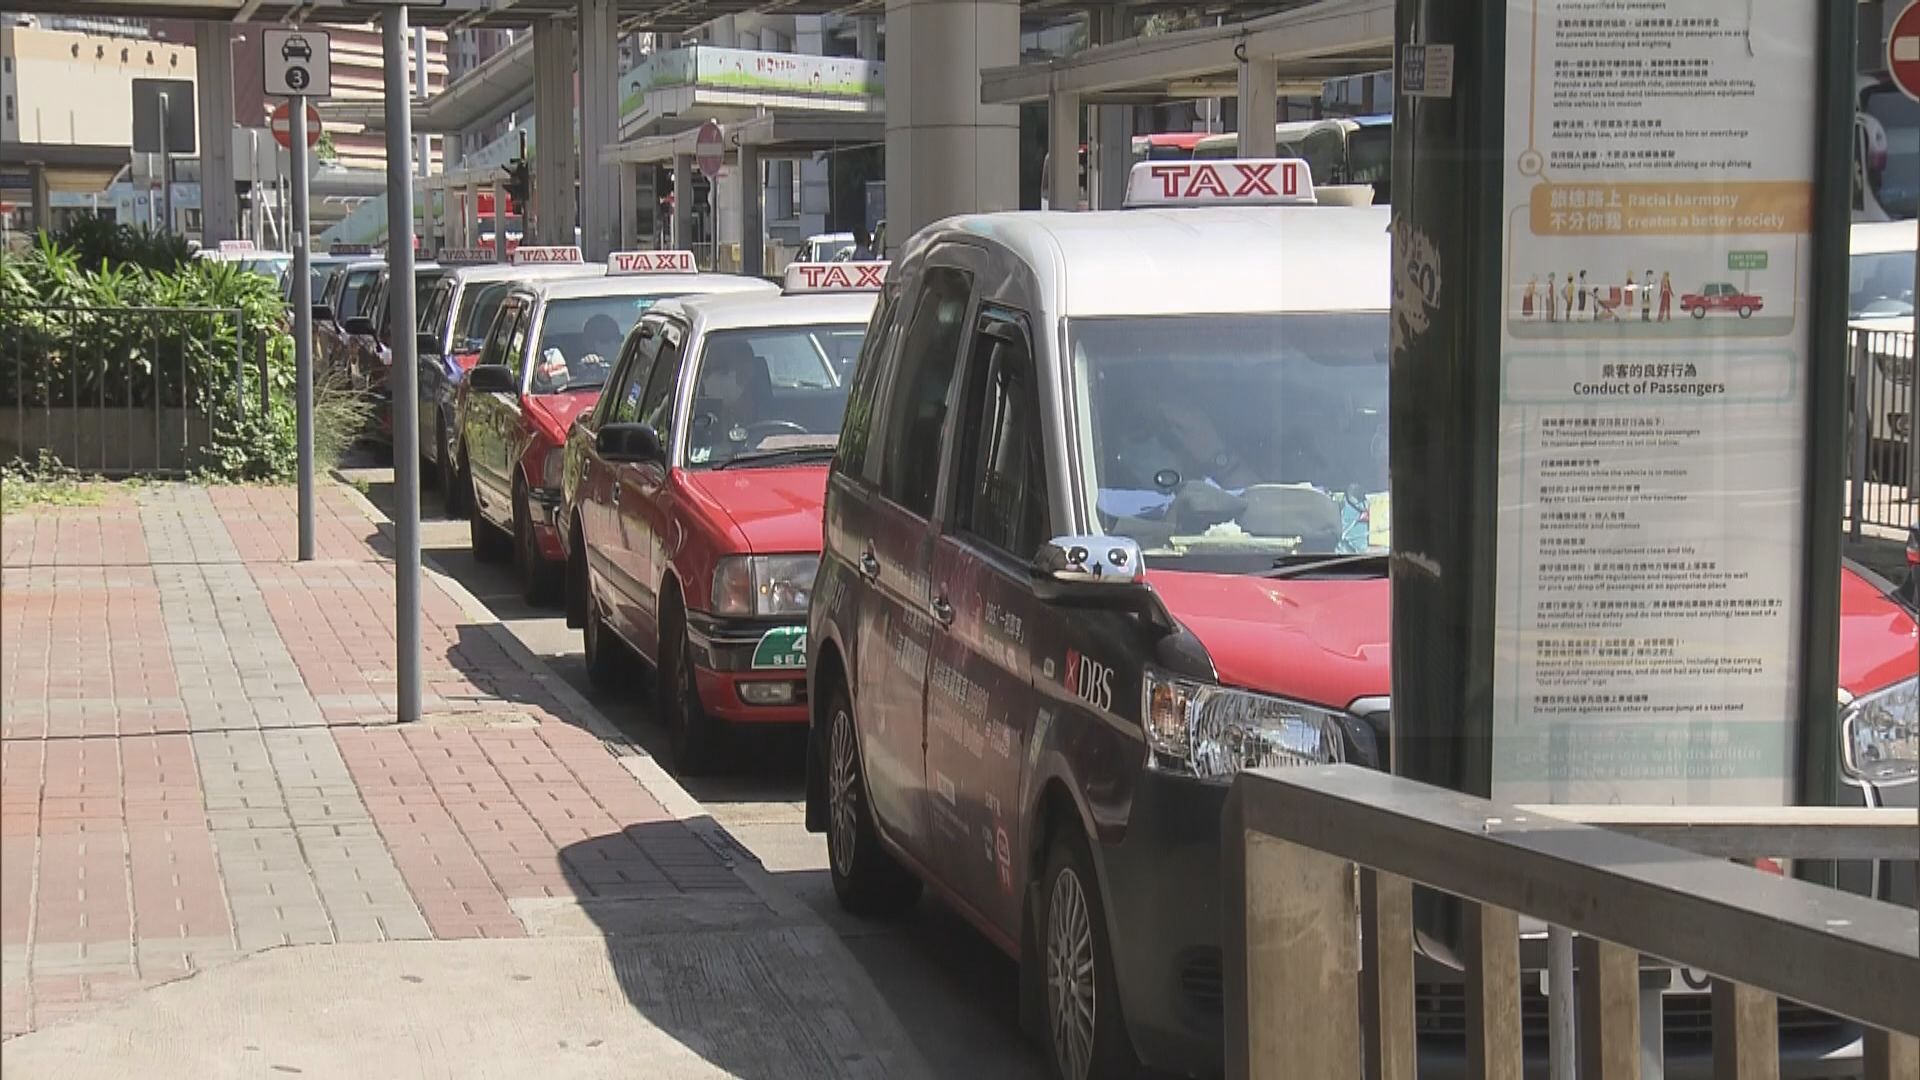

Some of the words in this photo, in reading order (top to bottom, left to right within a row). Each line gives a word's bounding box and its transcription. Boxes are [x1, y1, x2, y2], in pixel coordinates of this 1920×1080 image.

[293, 70, 303, 86] 3
[1152, 163, 1297, 198] TAXI
[1628, 192, 1671, 208] Racial
[1674, 190, 1739, 210] harmony
[1627, 213, 1677, 230] creates
[1679, 216, 1689, 228] a
[1691, 212, 1735, 227] better
[1737, 212, 1785, 230] society
[519, 248, 578, 261] TAXI
[616, 253, 689, 271] TAXI
[1573, 381, 1630, 395] Conduct
[1633, 381, 1648, 395] of
[1650, 381, 1725, 398] Passengers
[792, 634, 807, 653] 4
[1078, 655, 1114, 713] DBS
